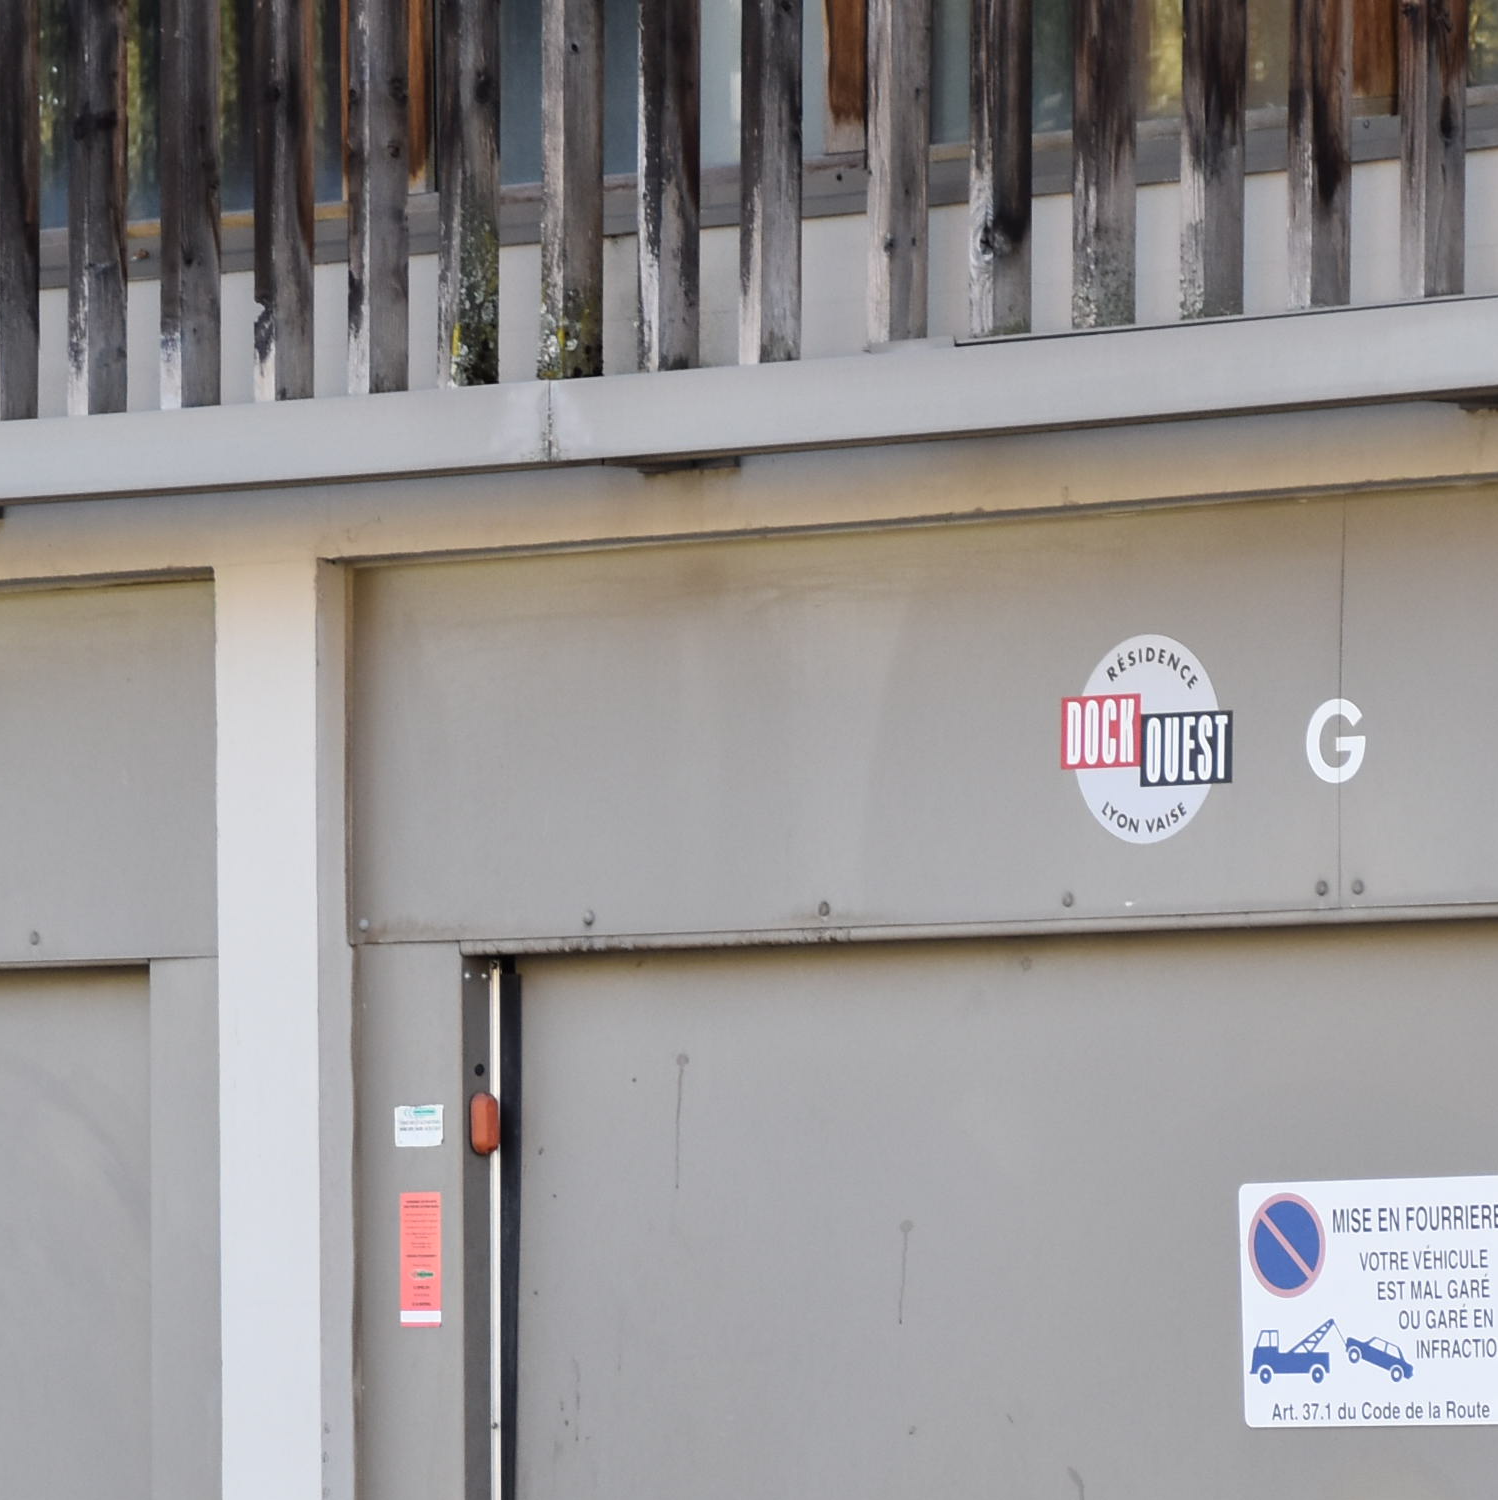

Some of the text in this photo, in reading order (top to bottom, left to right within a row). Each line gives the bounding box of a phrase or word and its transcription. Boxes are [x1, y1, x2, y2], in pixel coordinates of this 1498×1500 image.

[1106, 647, 1199, 690] RÉSIDENCE
[1066, 697, 1229, 784] DOCK OUEST
[1305, 698, 1367, 784] G
[1101, 801, 1188, 834] LYON VAISE
[1331, 1207, 1373, 1234] MISE
[1378, 1206, 1401, 1233] EN
[1359, 1244, 1490, 1272] VOTRE VÉHICULE
[1377, 1273, 1491, 1301] EST MAL GARÉ
[1398, 1303, 1494, 1330] OU GARÉ EN
[1271, 1400, 1491, 1421] Art. 37.1 du Code de la Route
